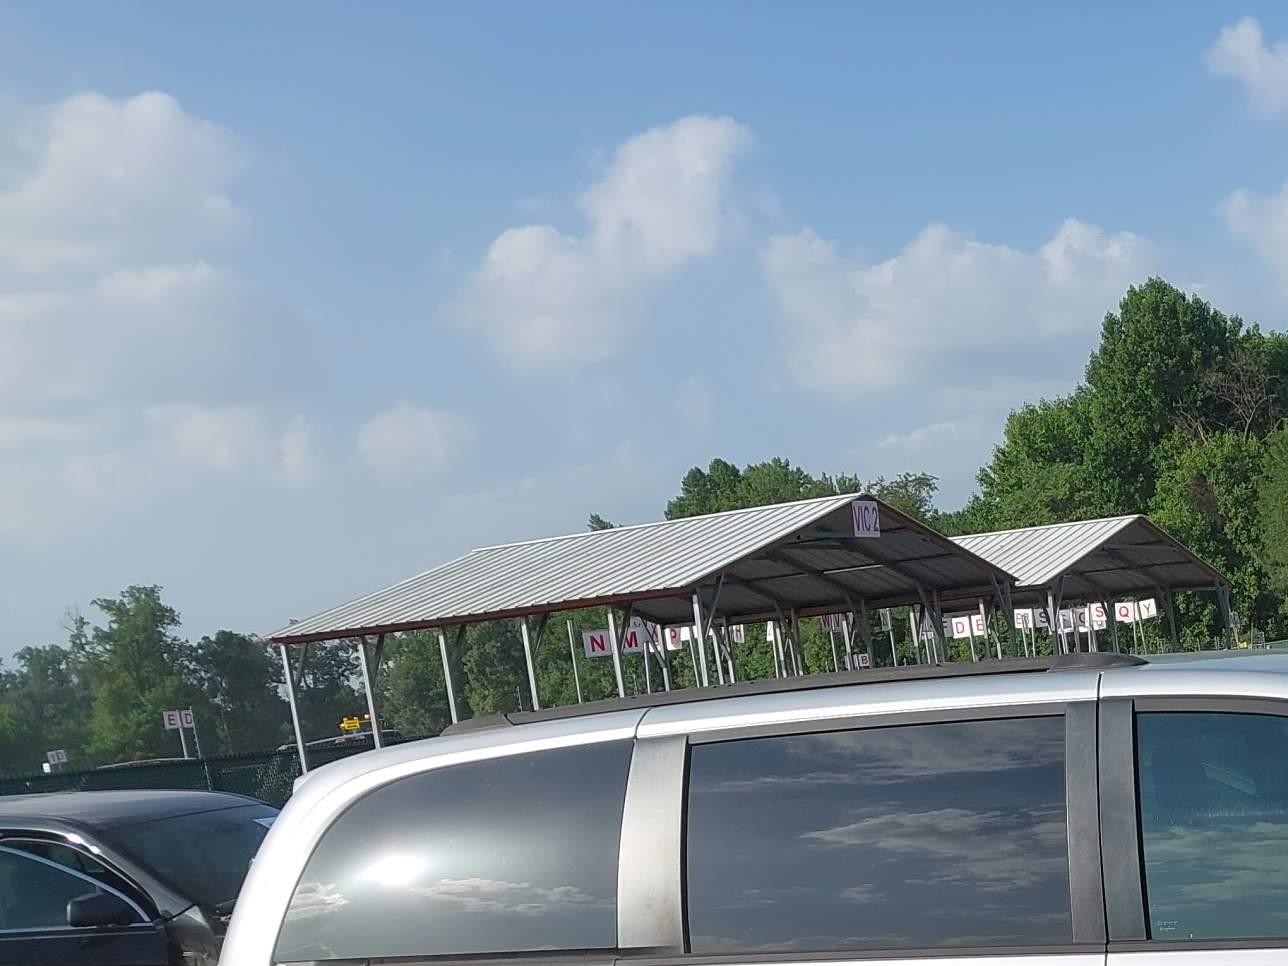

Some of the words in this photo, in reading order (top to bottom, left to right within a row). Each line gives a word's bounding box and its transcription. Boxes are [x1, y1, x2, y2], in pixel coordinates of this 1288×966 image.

[853, 506, 870, 531] VIC
[872, 506, 880, 532] 2
[1095, 605, 1104, 617] S
[1118, 605, 1129, 618] Q
[1143, 602, 1151, 615] Y
[955, 621, 965, 634] D
[590, 635, 605, 652] N
[861, 655, 869, 665] B
[167, 714, 177, 726] E
